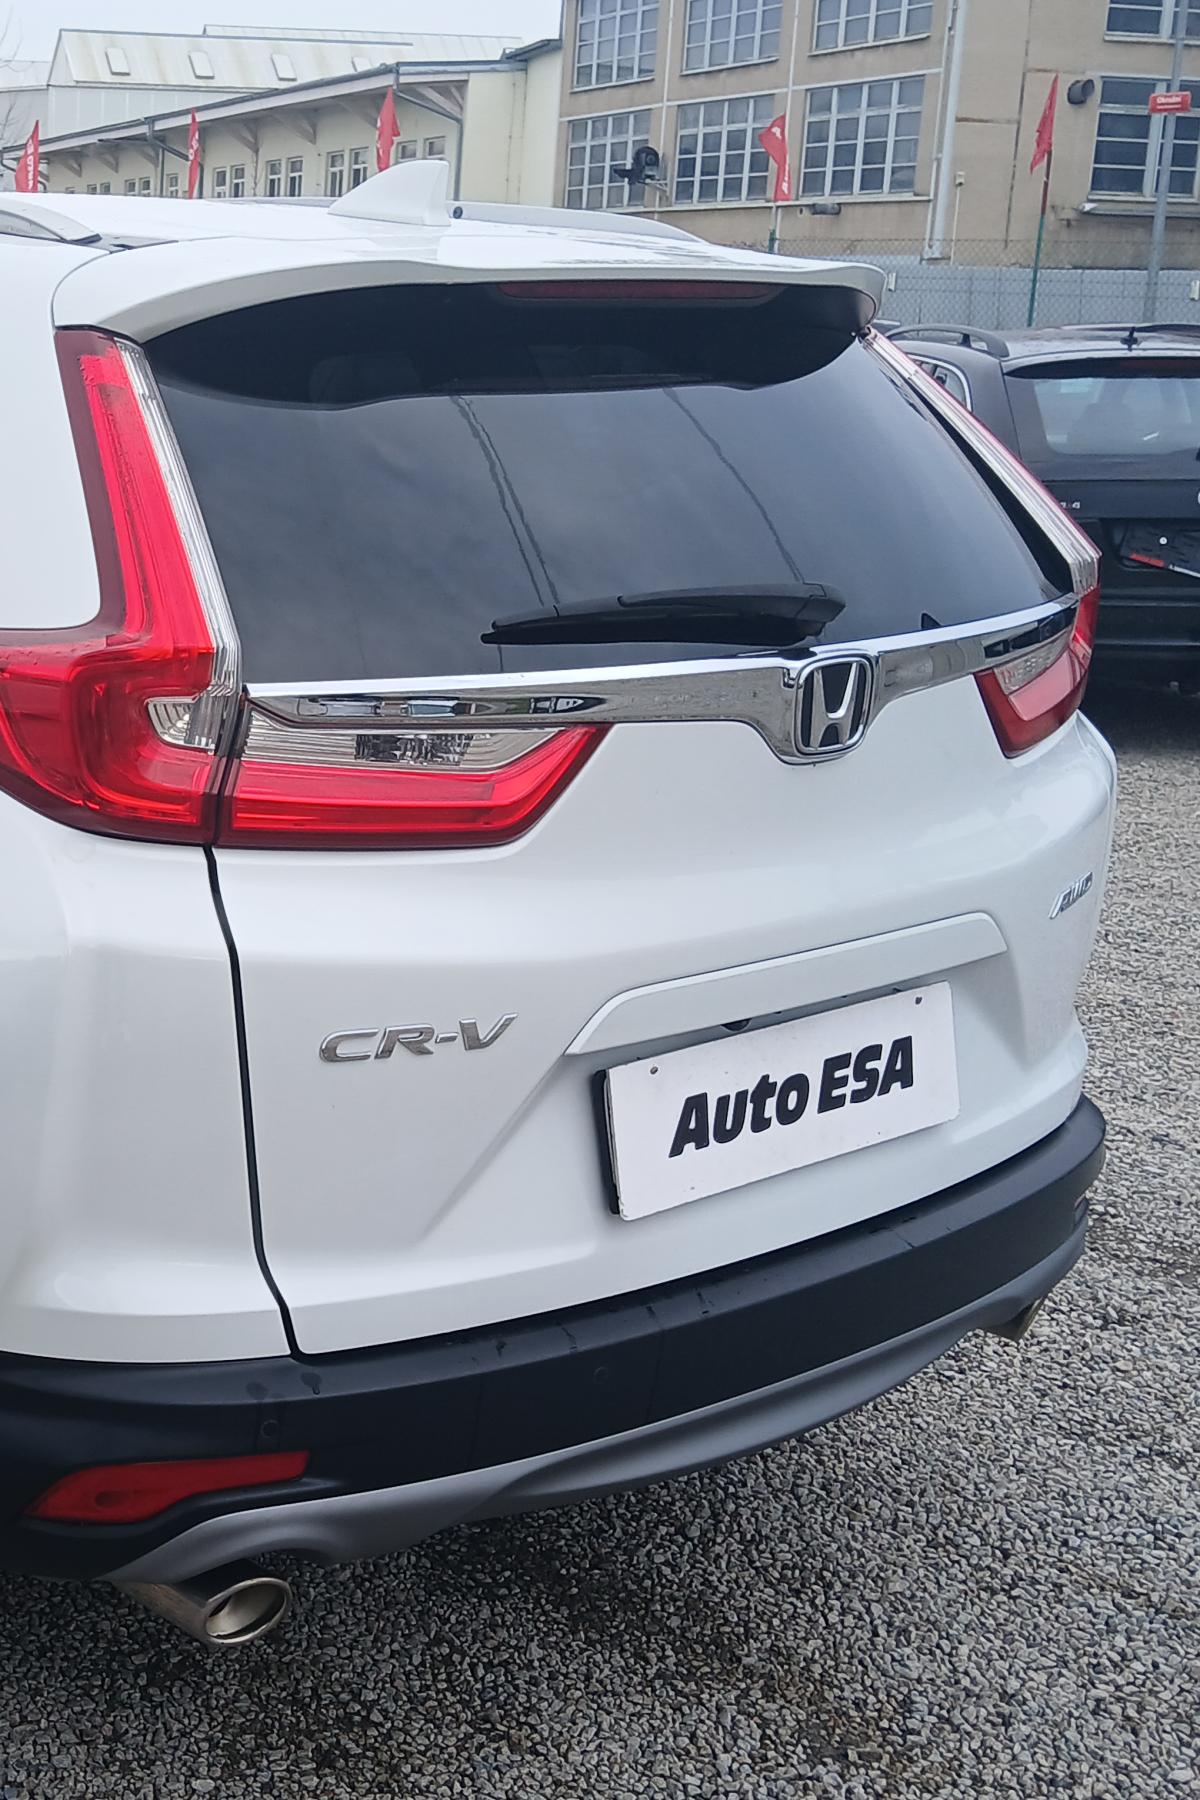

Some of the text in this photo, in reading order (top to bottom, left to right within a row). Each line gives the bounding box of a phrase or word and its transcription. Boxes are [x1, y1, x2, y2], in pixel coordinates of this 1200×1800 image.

[319, 1012, 519, 1063] CR-V
[668, 1035, 914, 1159] Auto ESA
